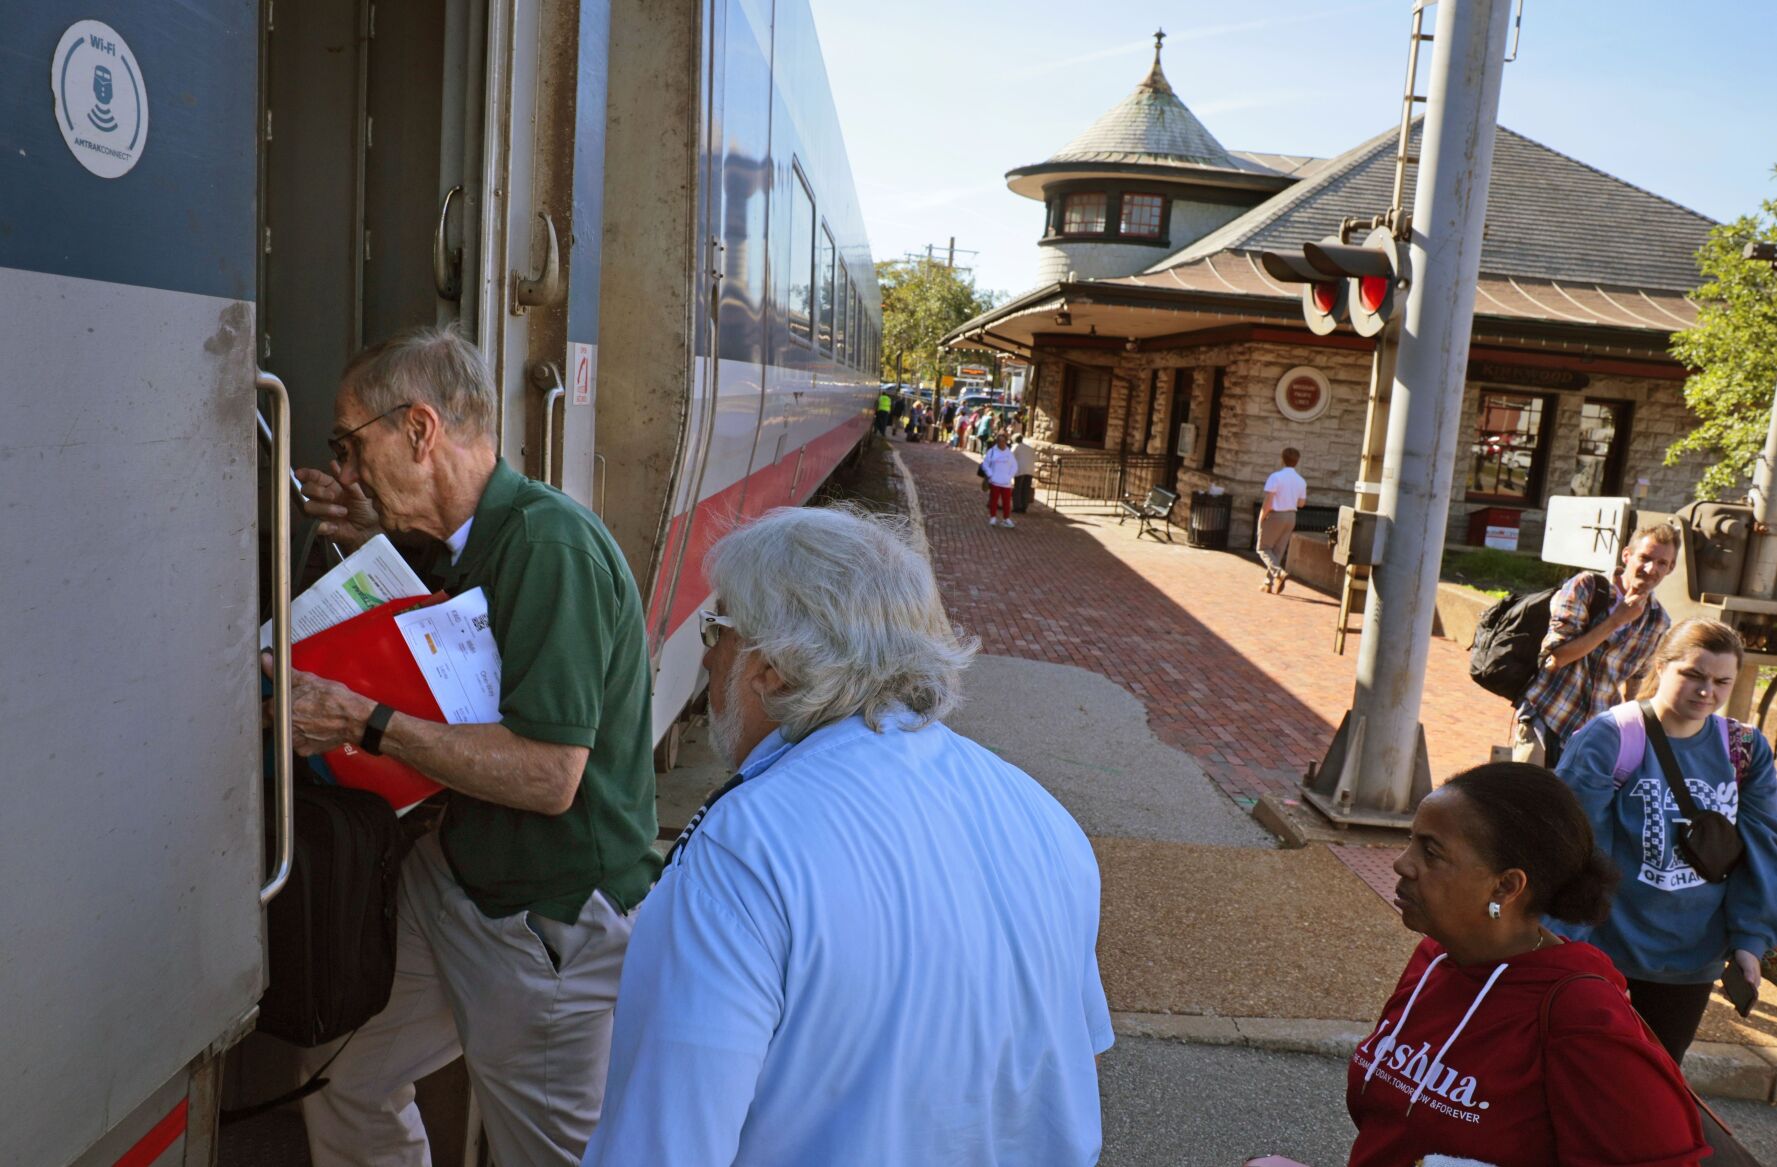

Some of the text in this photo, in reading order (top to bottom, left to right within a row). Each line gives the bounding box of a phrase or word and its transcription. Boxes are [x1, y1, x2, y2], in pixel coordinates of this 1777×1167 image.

[90, 34, 116, 57] Wi-Fi
[1482, 363, 1574, 383] KIRKWOOD
[1644, 870, 1666, 885] OF
[1429, 1099, 1480, 1124] &FOREVER
